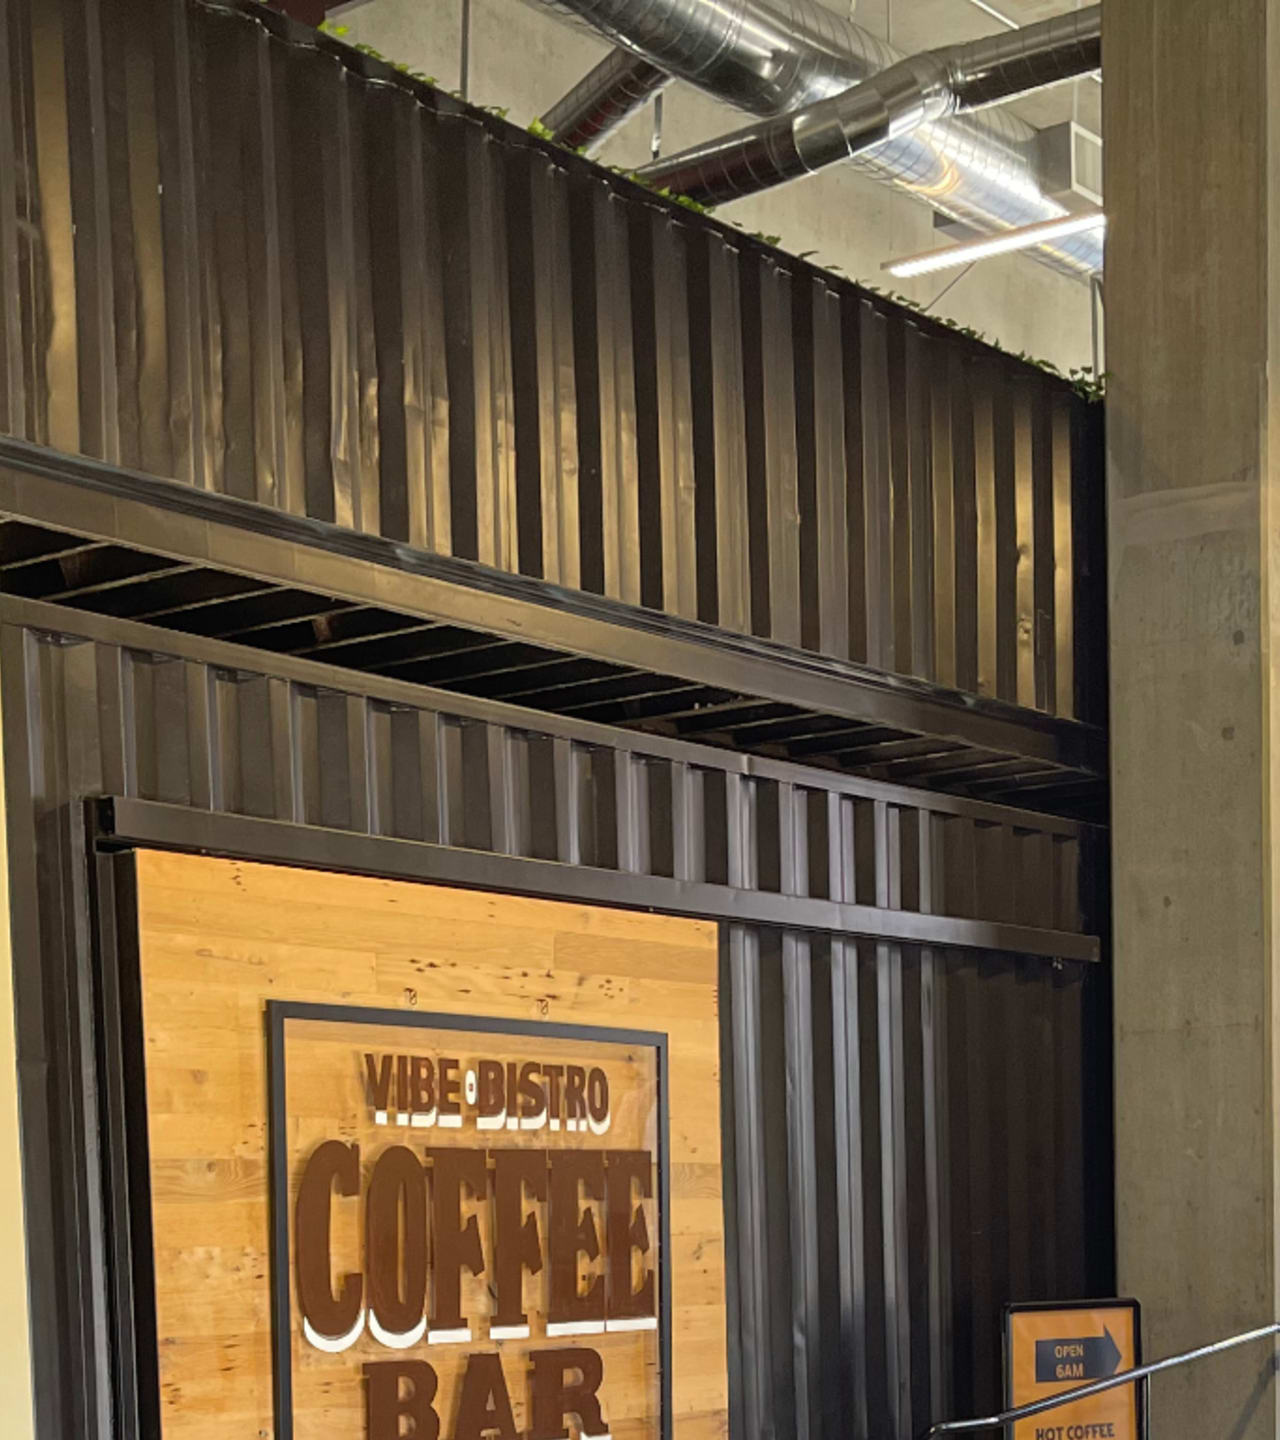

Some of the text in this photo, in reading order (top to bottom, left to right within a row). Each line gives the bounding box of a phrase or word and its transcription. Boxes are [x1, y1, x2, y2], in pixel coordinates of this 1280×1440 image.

[364, 1053, 611, 1135] VIBE BISTRO
[296, 1139, 658, 1352] COFFEE
[1054, 1343, 1084, 1359] OPEN
[1055, 1363, 1084, 1379] 6AM
[1066, 1422, 1116, 1440] COFFEE
